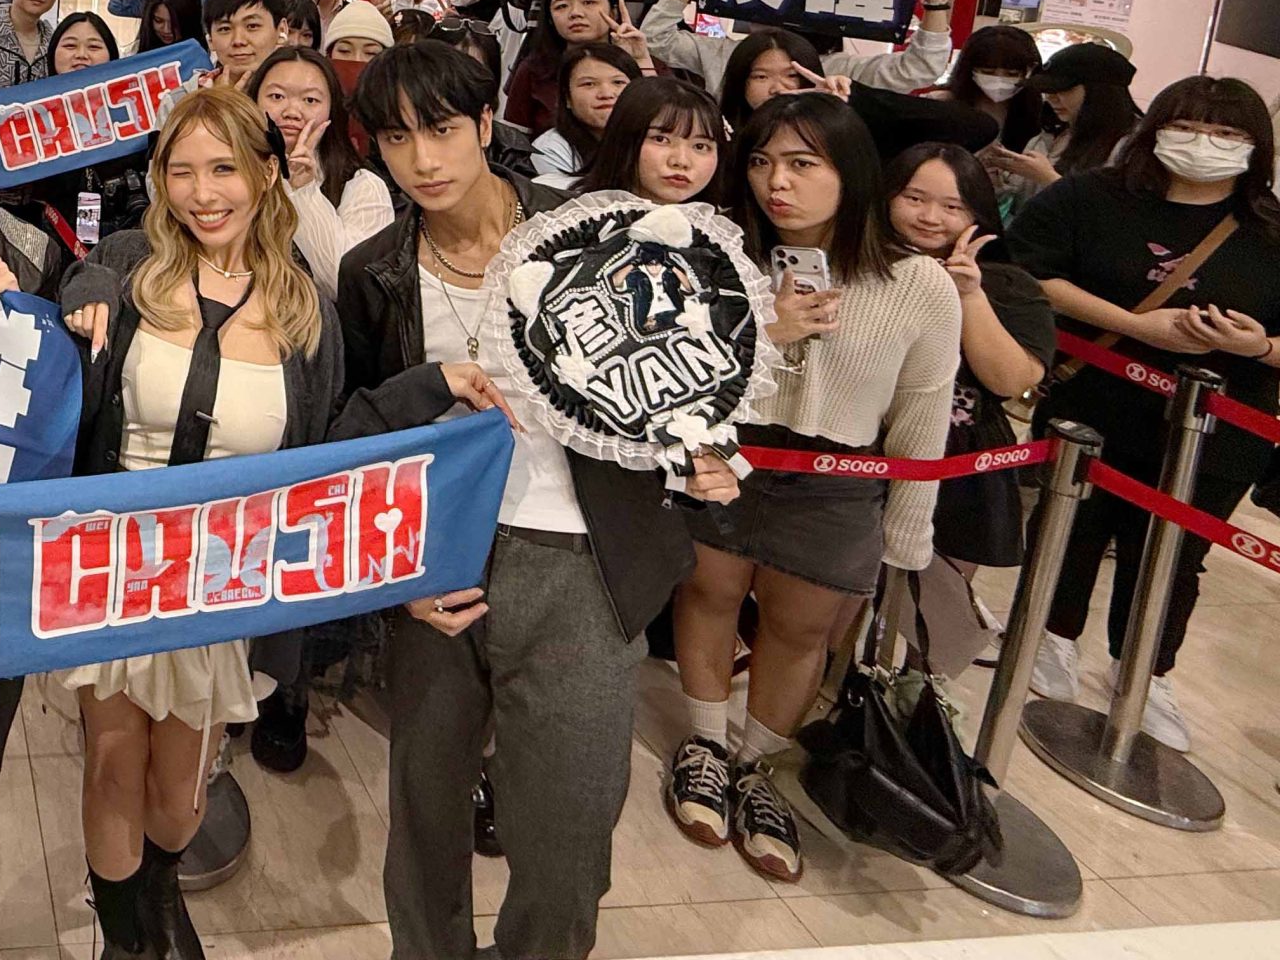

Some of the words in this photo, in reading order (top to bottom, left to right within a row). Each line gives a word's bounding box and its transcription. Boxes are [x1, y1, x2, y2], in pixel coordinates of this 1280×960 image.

[588, 336, 729, 416] YAN
[1148, 373, 1177, 391] SO
[992, 448, 1030, 467] SOGO
[838, 459, 888, 475] SOGO
